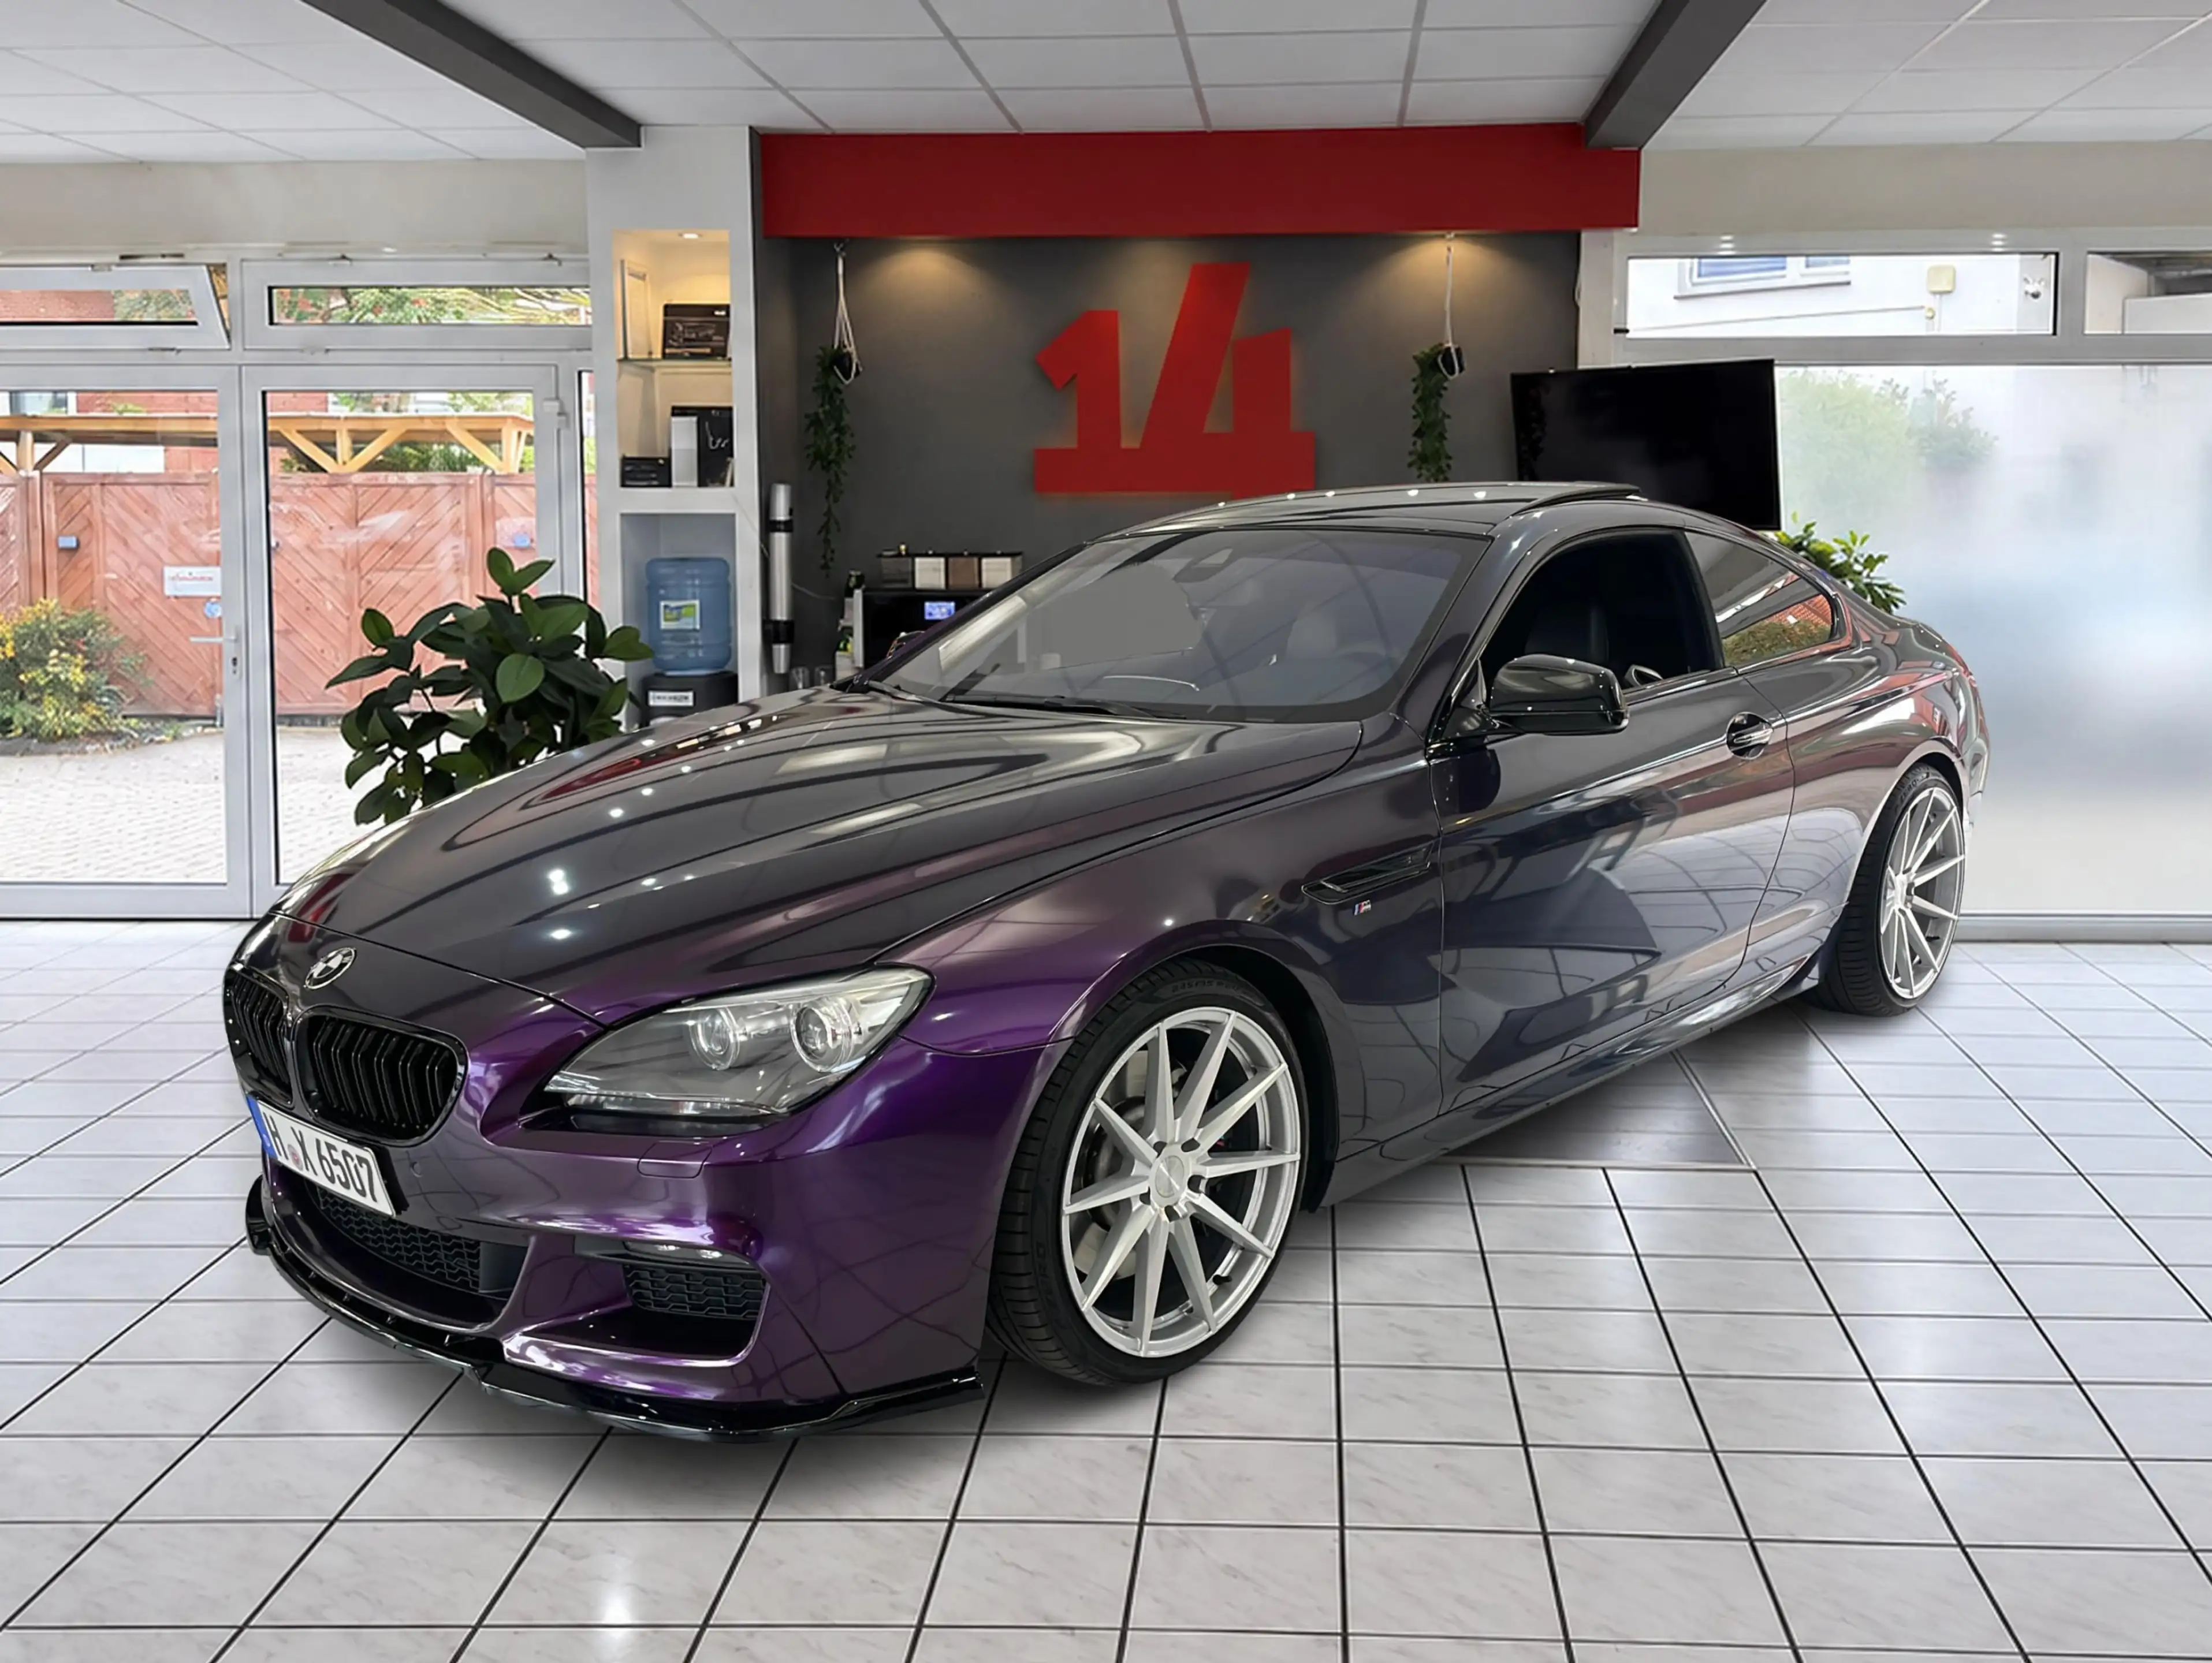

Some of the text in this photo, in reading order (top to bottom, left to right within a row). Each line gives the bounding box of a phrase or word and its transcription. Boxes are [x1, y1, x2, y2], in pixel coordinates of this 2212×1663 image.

[1034, 261, 1316, 499] 14
[262, 1111, 378, 1203] H X 6507
